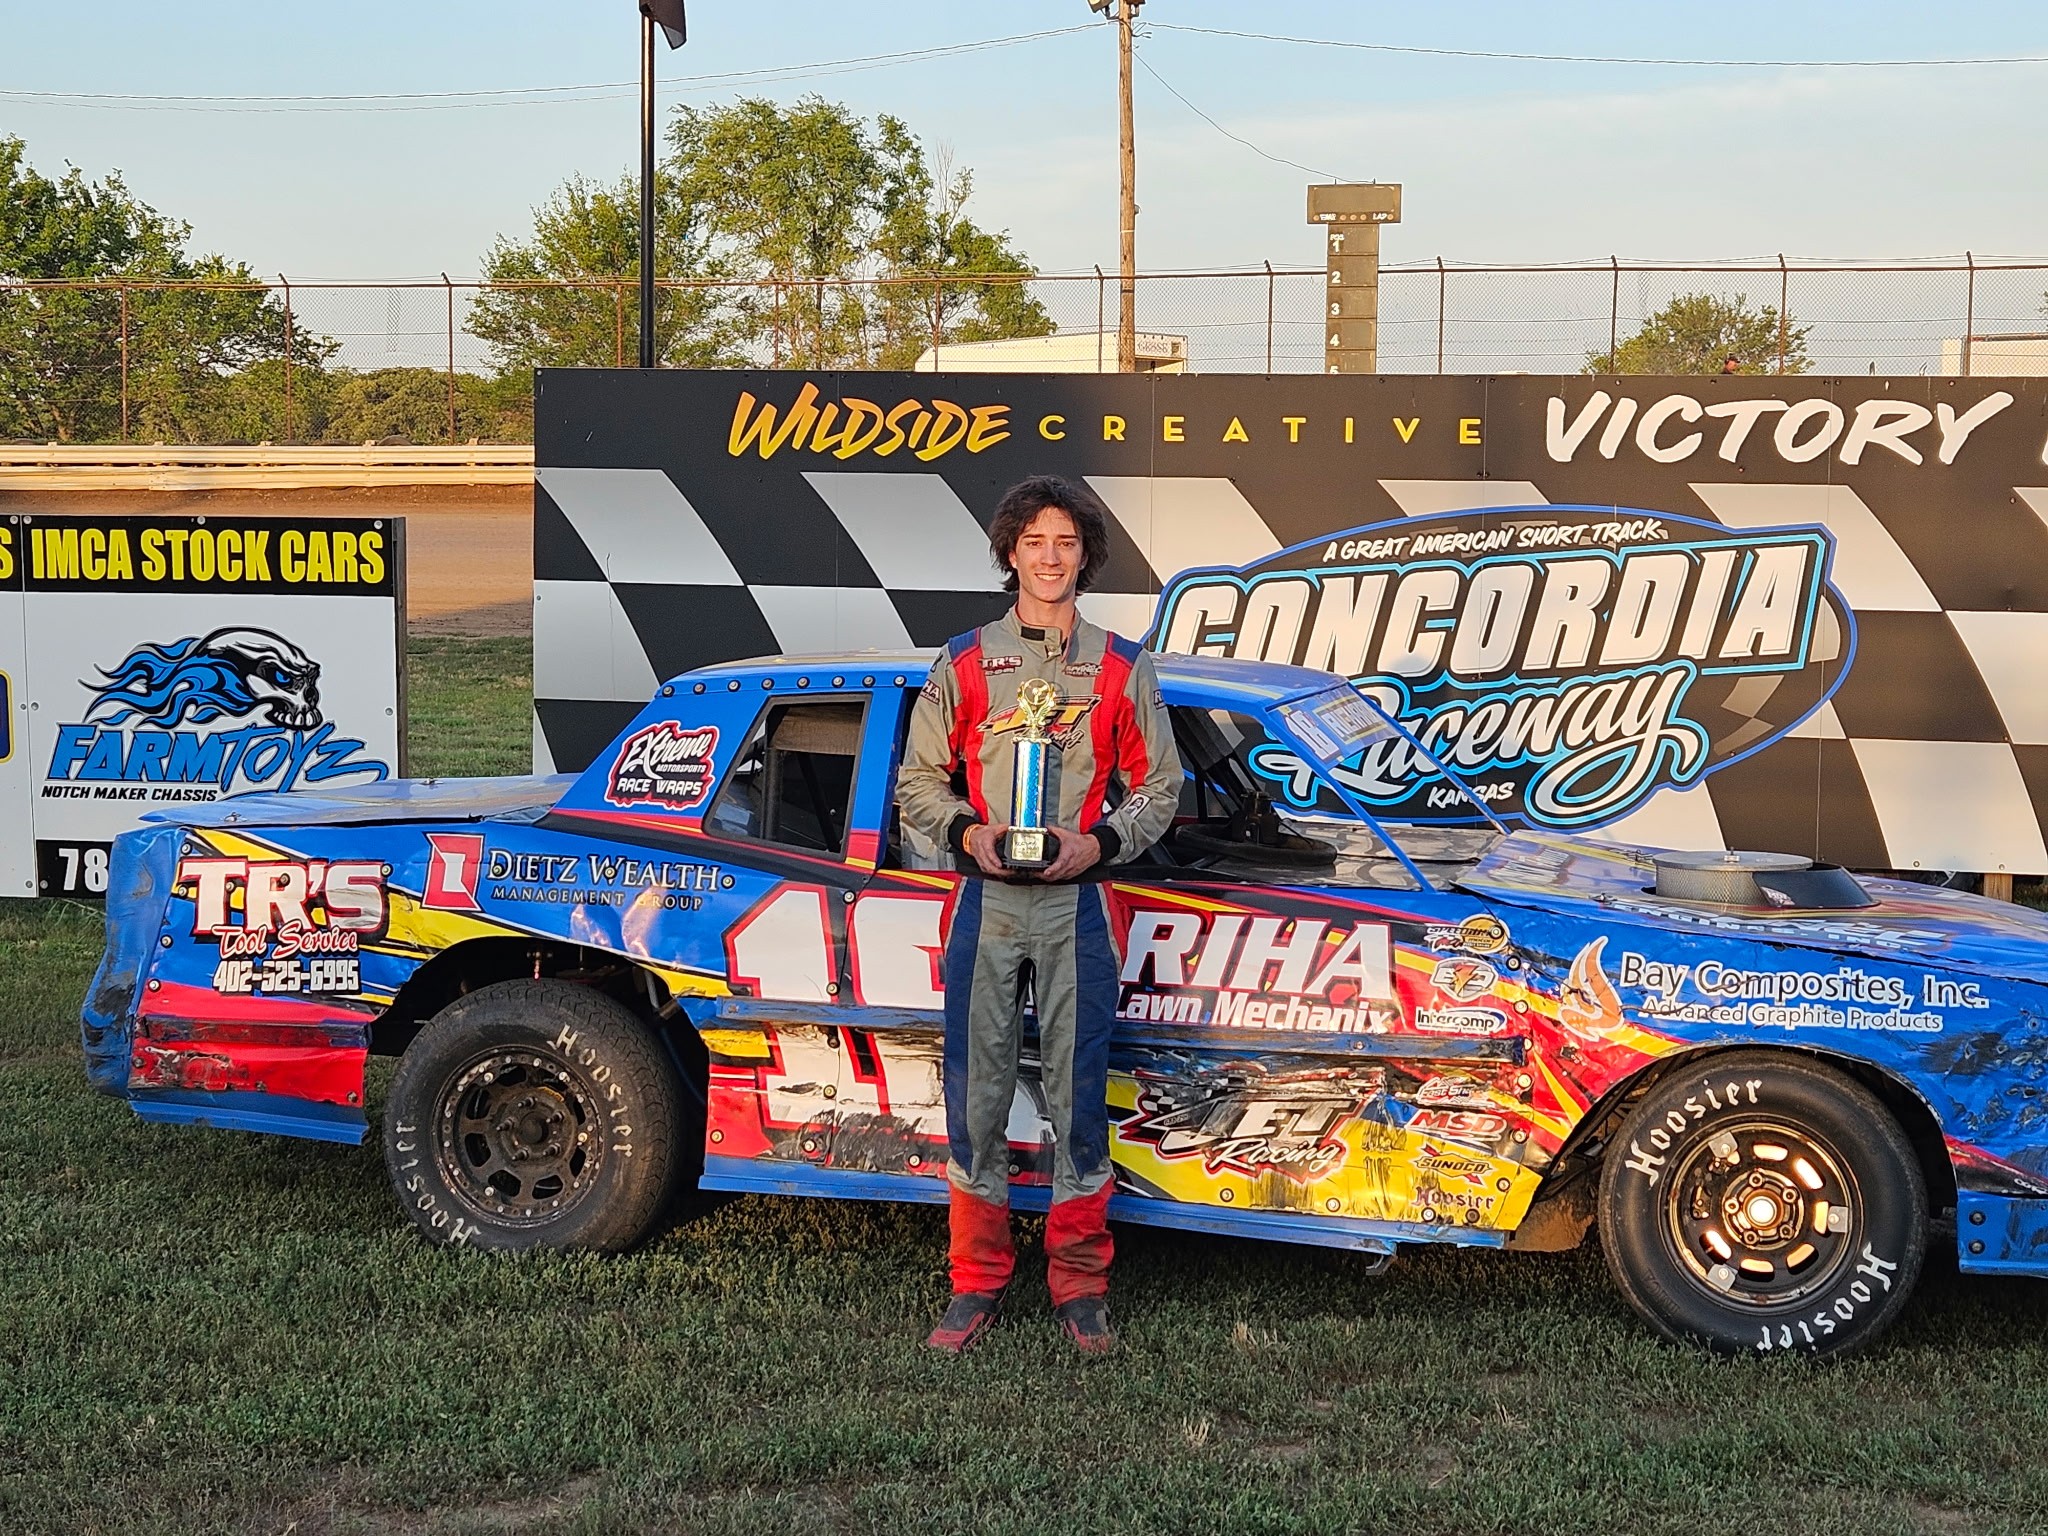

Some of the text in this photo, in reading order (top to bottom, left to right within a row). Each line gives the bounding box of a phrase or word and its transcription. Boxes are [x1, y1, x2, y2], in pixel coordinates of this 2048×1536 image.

[1331, 271, 1341, 284] 2
[1331, 303, 1340, 315] 3
[1330, 334, 1340, 347] 4
[727, 382, 2014, 466] WILDSIDE CREATIVE VICTORY
[30, 528, 134, 581] IMCA
[140, 529, 270, 583] STOCK
[279, 531, 385, 584] CARS
[1323, 518, 1664, 562] A GREAT AMERICAN SHORT TRACK
[1162, 544, 1810, 677] CONCORDIA
[1258, 667, 1696, 817] Raceway
[616, 777, 703, 796] RACE WRAPS
[655, 763, 707, 773] MOTORSPORTS
[41, 785, 218, 802] NOTCH MAKER CHASSIS
[1427, 783, 1516, 809] KANSAS
[488, 850, 719, 891] DIETZ WEALTH
[180, 861, 387, 932] TR'S
[492, 886, 625, 906] MANAGEMENT
[211, 921, 358, 959] Tool Service
[1120, 911, 1394, 1000] RIHA
[213, 959, 359, 992] 402-525-6995
[1623, 955, 1988, 1008] Bay Composites, Inc.
[1212, 990, 1393, 1034] Mechanix
[1643, 1000, 1941, 1030] Advanced Graphite Products
[1410, 1112, 1506, 1133] MSD
[1625, 1076, 1763, 1187] Hoosier
[1420, 1158, 1485, 1173] SUNOCO
[1756, 1241, 1898, 1352] Hoosier
